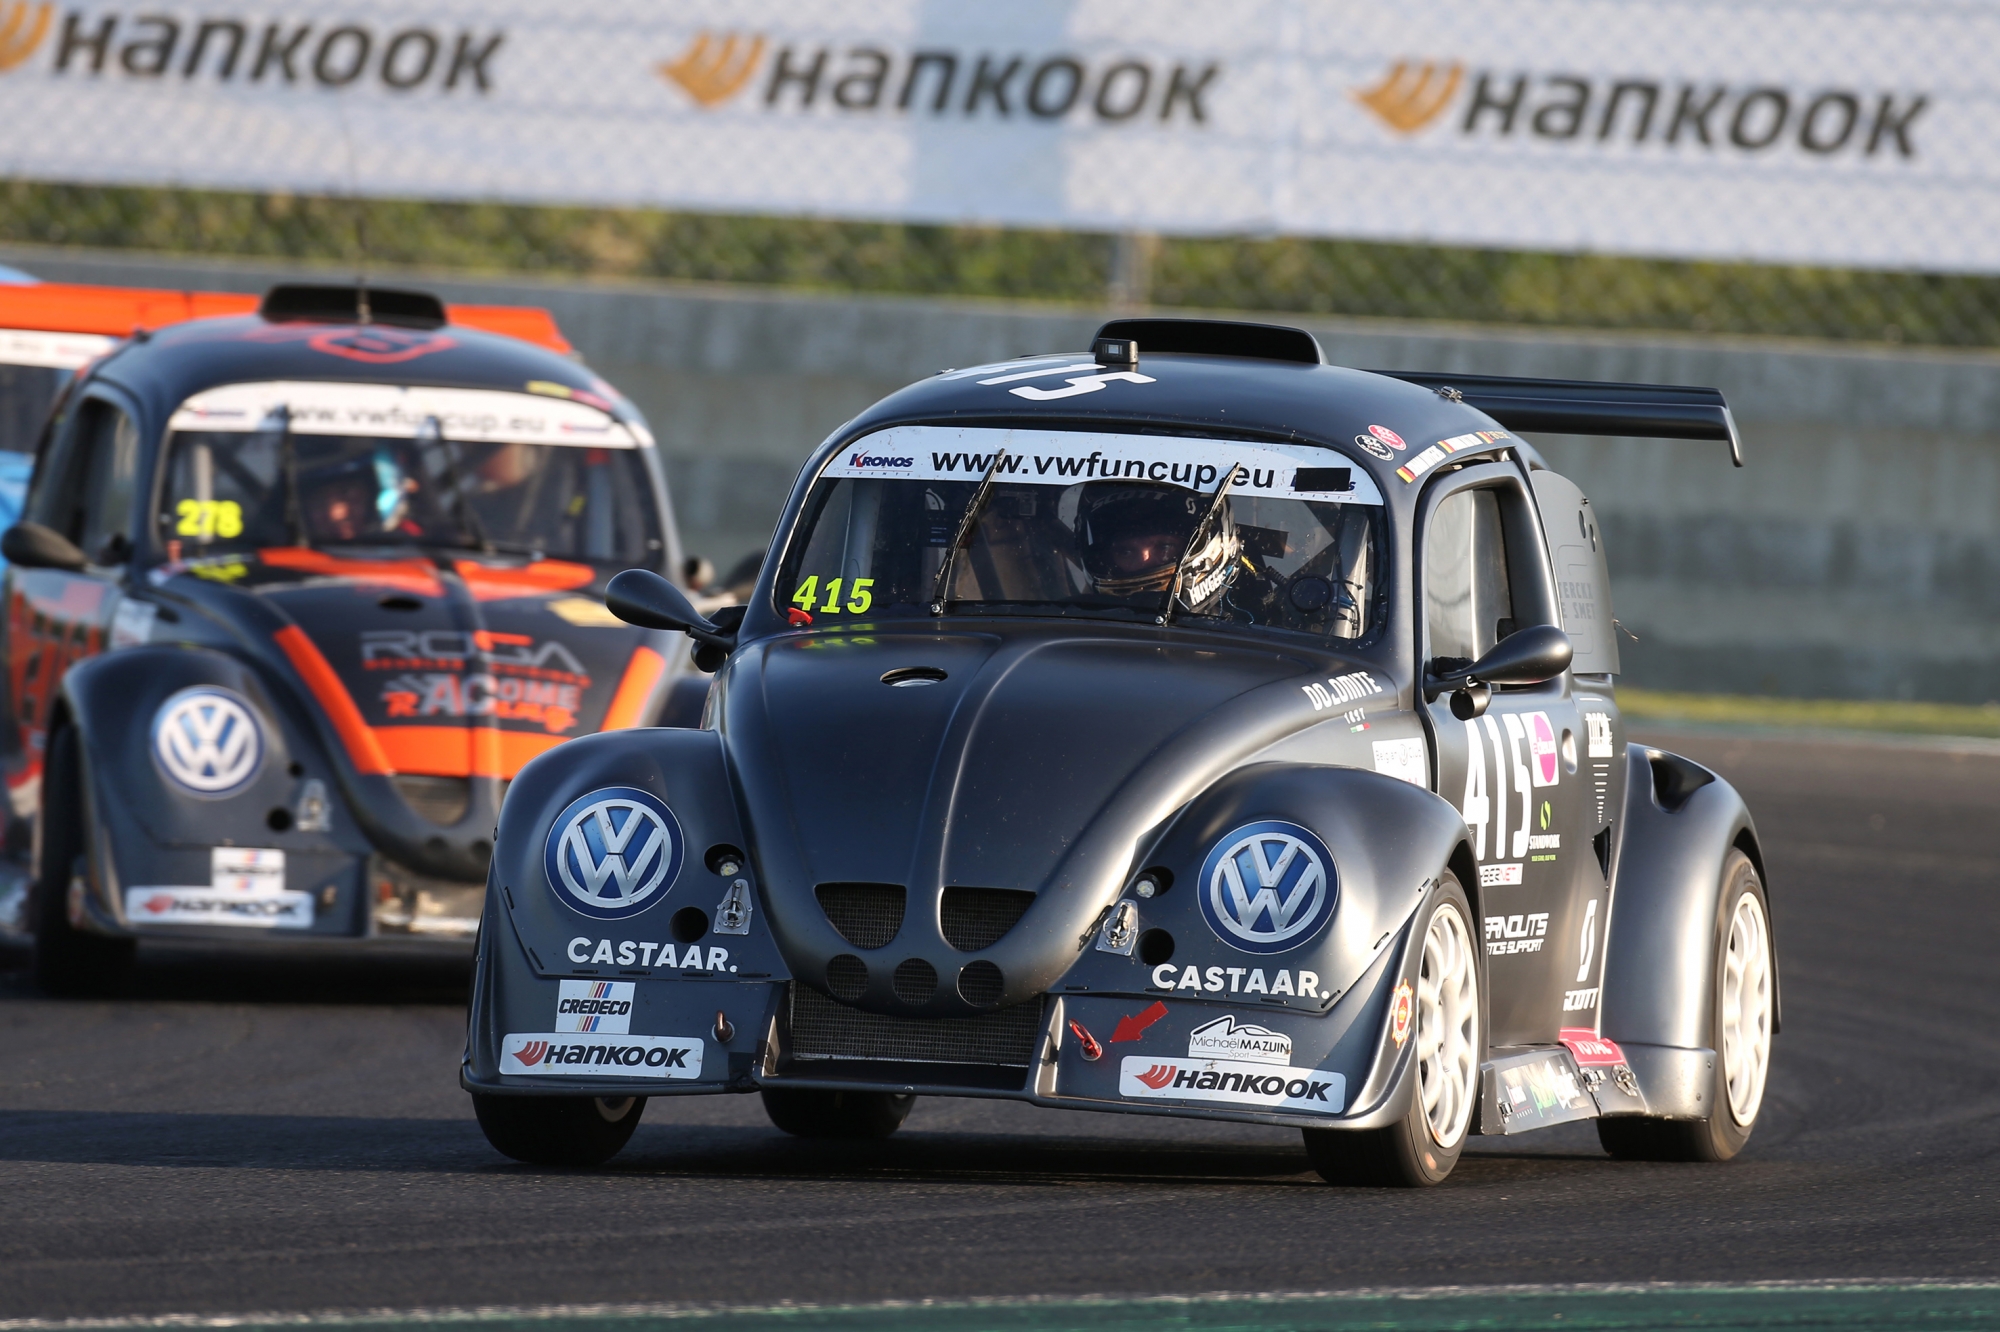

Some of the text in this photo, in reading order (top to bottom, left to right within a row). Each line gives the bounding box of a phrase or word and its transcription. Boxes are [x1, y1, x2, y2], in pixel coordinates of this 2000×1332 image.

[849, 450, 914, 467] KRONOS
[932, 452, 1274, 489] www.vwfuncup.eu
[175, 498, 244, 538] 278
[792, 575, 874, 614] 415
[1302, 671, 1382, 711] DOLOMITE
[1463, 713, 1532, 861] 415
[567, 937, 738, 973] CASTAAR.
[1152, 964, 1330, 999] CASTAAR.
[558, 998, 631, 1016] CREDECO
